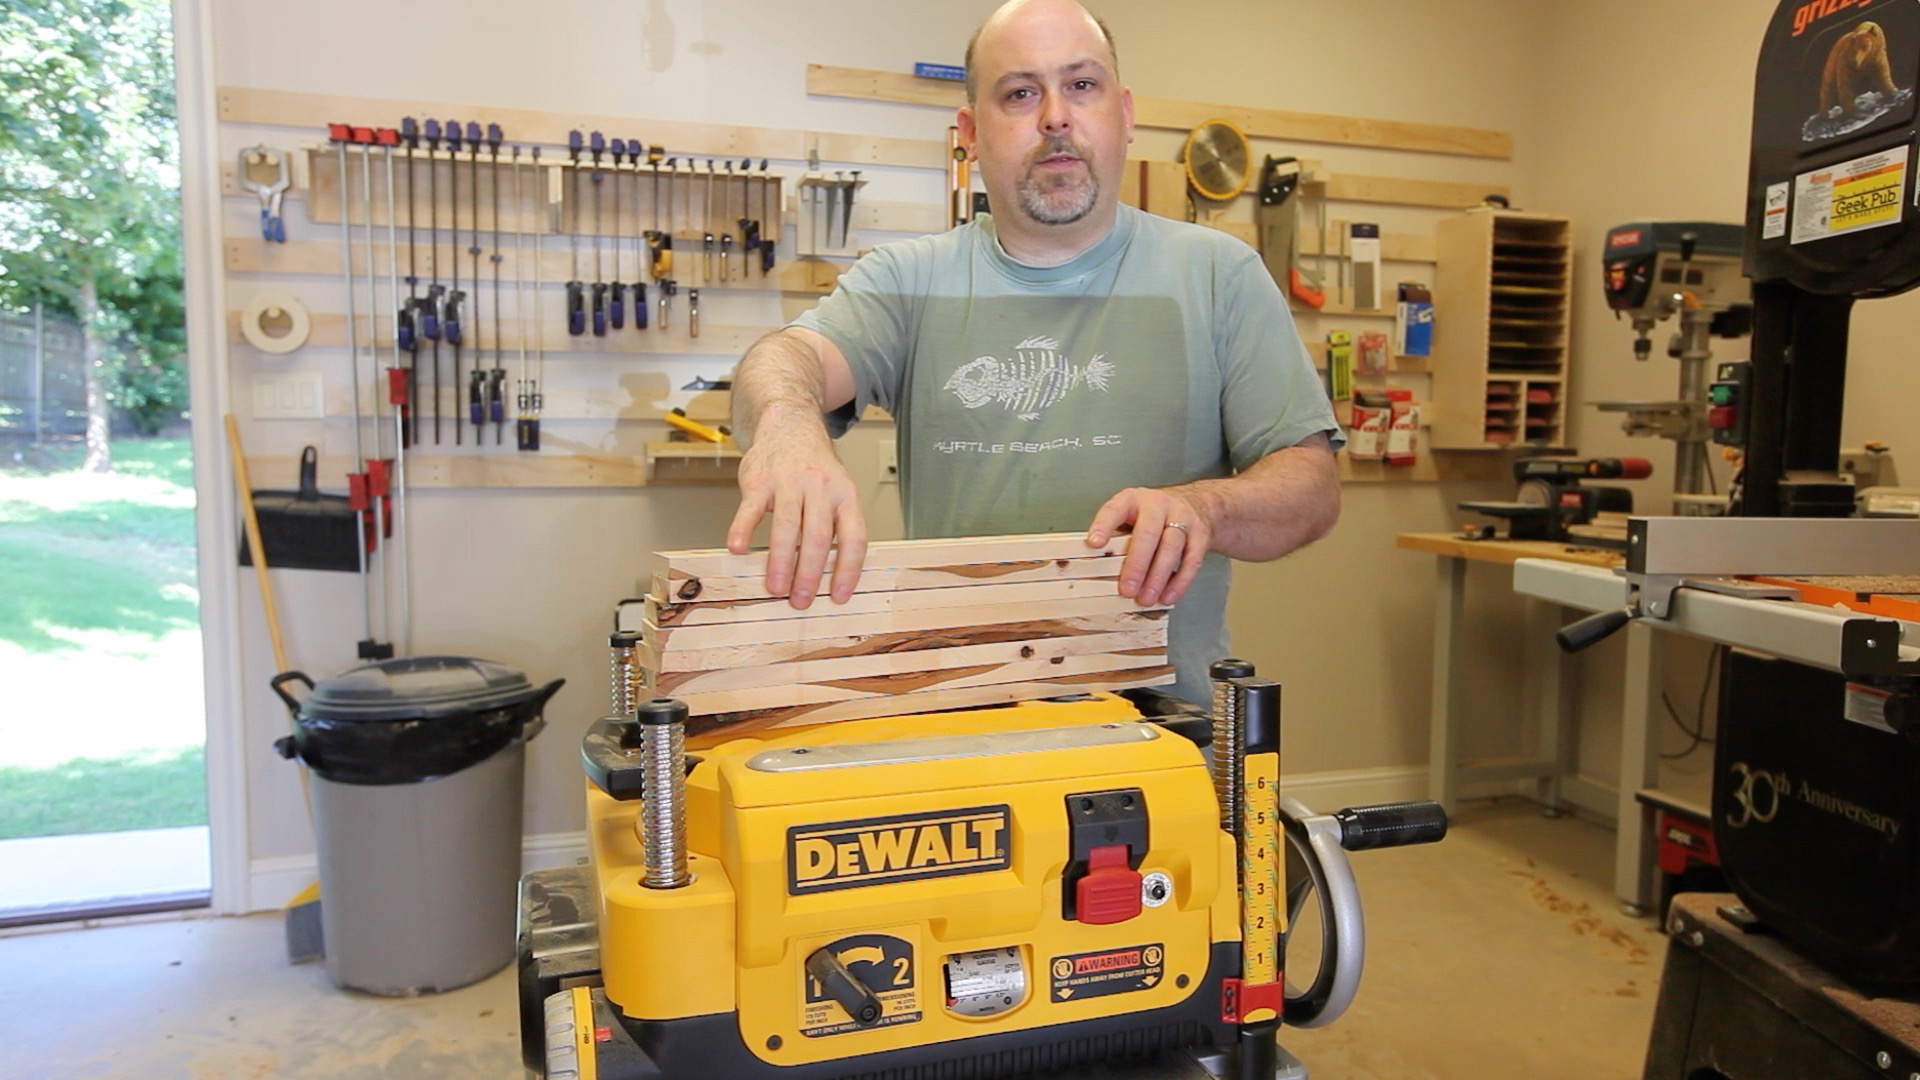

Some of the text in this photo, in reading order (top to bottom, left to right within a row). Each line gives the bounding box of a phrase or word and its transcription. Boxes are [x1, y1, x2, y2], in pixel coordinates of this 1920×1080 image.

[1836, 189, 1896, 216] Geek Pub
[932, 441, 1004, 454] MYRTLE
[1092, 435, 1122, 446] SC
[1257, 776, 1265, 789] 6
[1257, 812, 1265, 825] 5
[1797, 779, 1900, 844] Anniversary
[1257, 847, 1265, 860] 4
[1257, 882, 1265, 895] 3
[1257, 916, 1264, 929] 2
[1089, 953, 1139, 970] WARNING
[892, 957, 910, 986] 2
